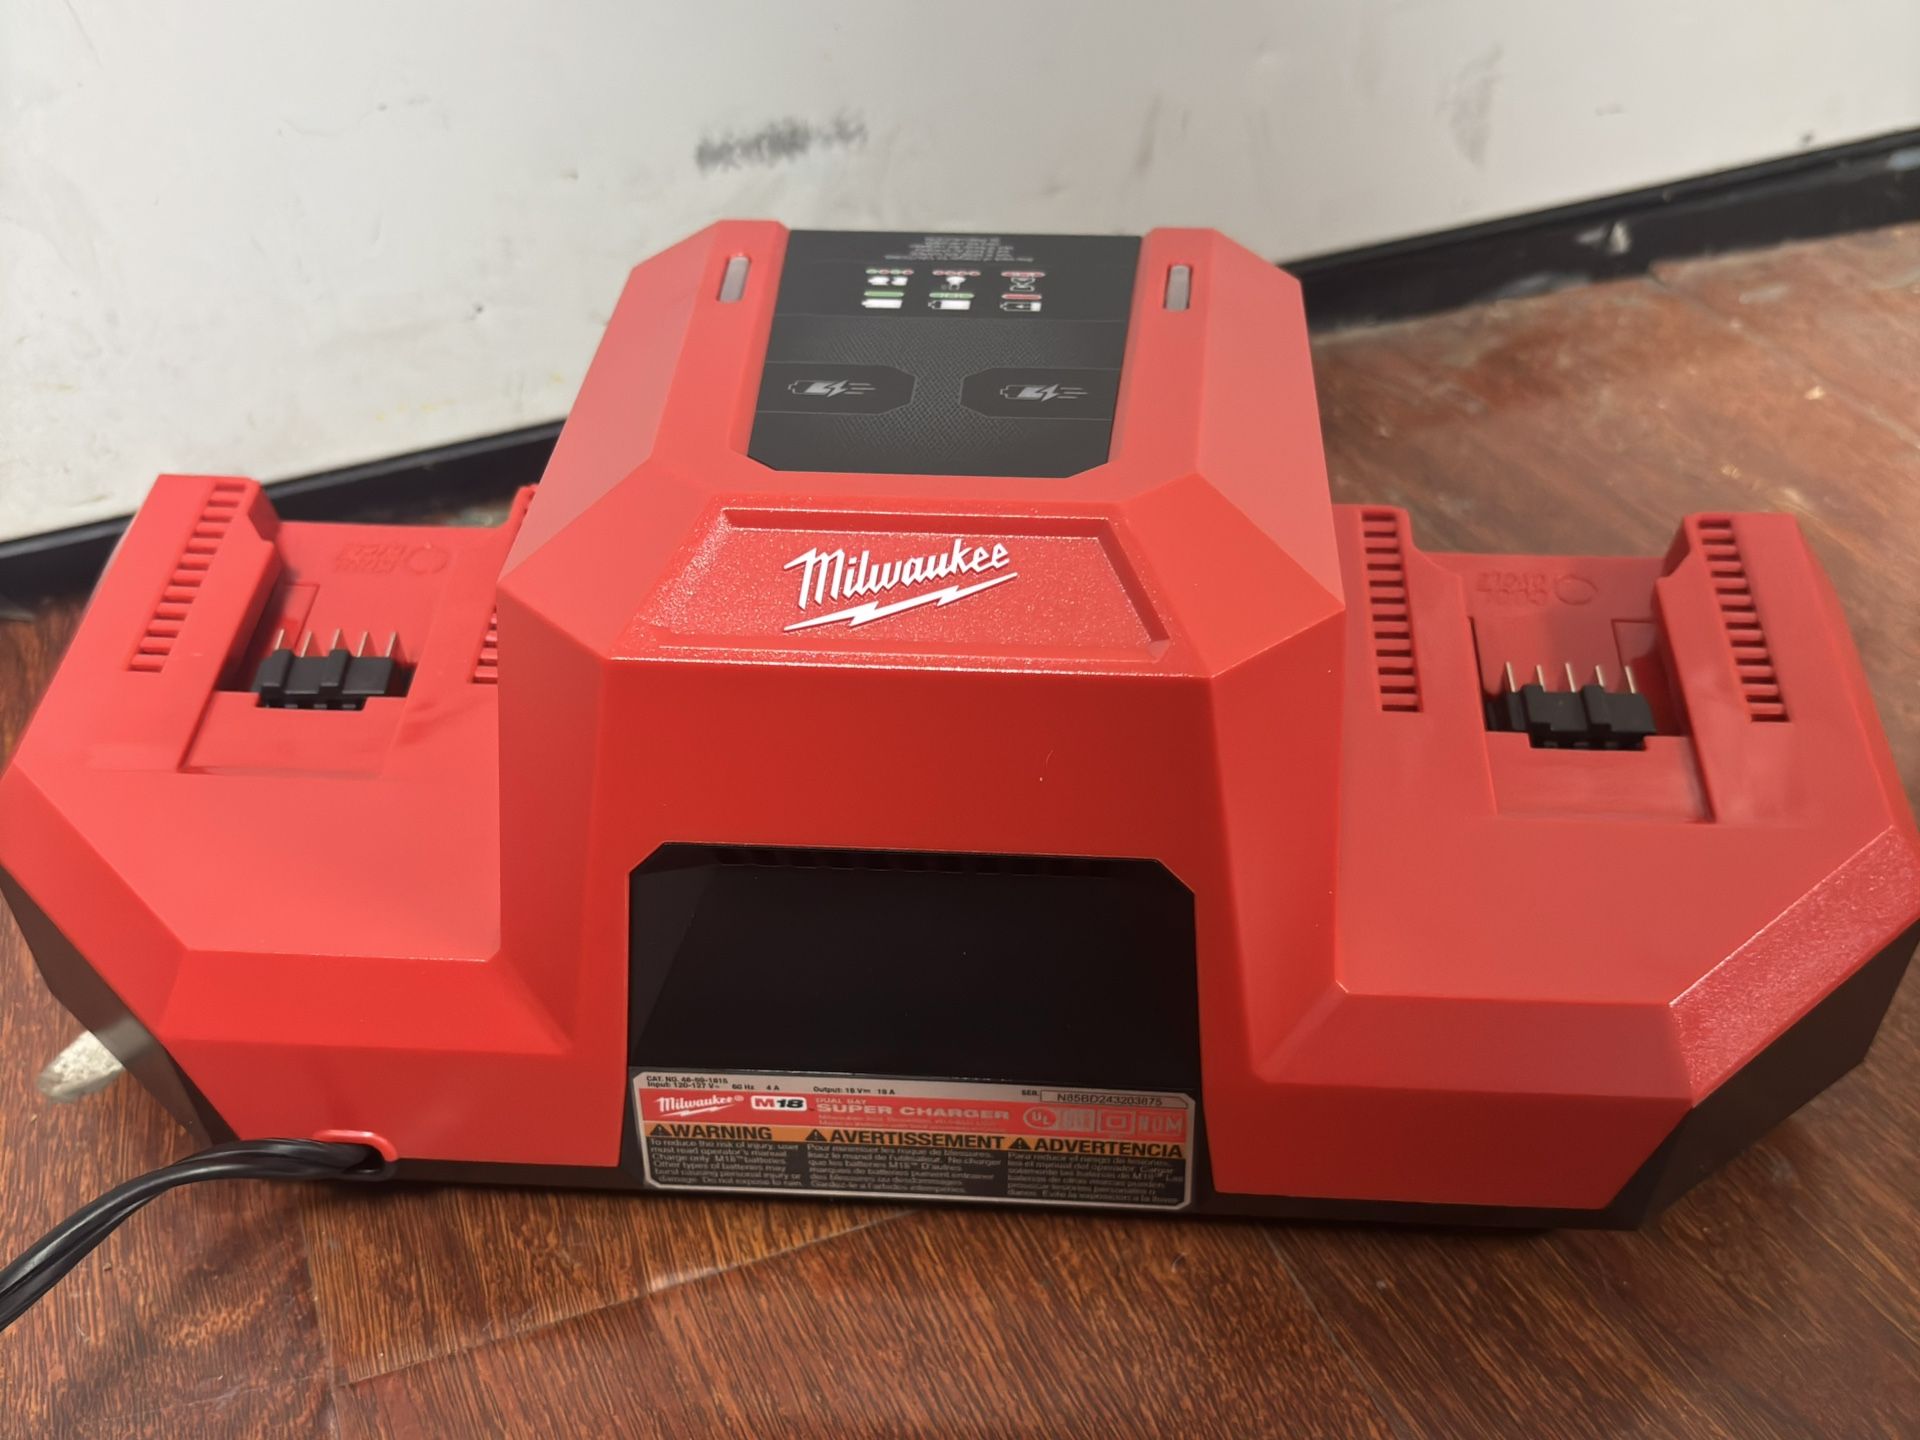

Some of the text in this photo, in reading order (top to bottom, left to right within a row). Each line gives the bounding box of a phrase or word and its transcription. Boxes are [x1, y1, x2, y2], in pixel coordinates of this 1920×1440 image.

[783, 538, 1010, 609] Milwaukee
[754, 1098, 804, 1109] M18
[816, 1103, 1009, 1121] SUPER CHARGER
[670, 1124, 773, 1140] WARNING
[830, 1129, 1004, 1149] AVERTISSEMENT
[1034, 1138, 1183, 1157] ADVERTENCIA
